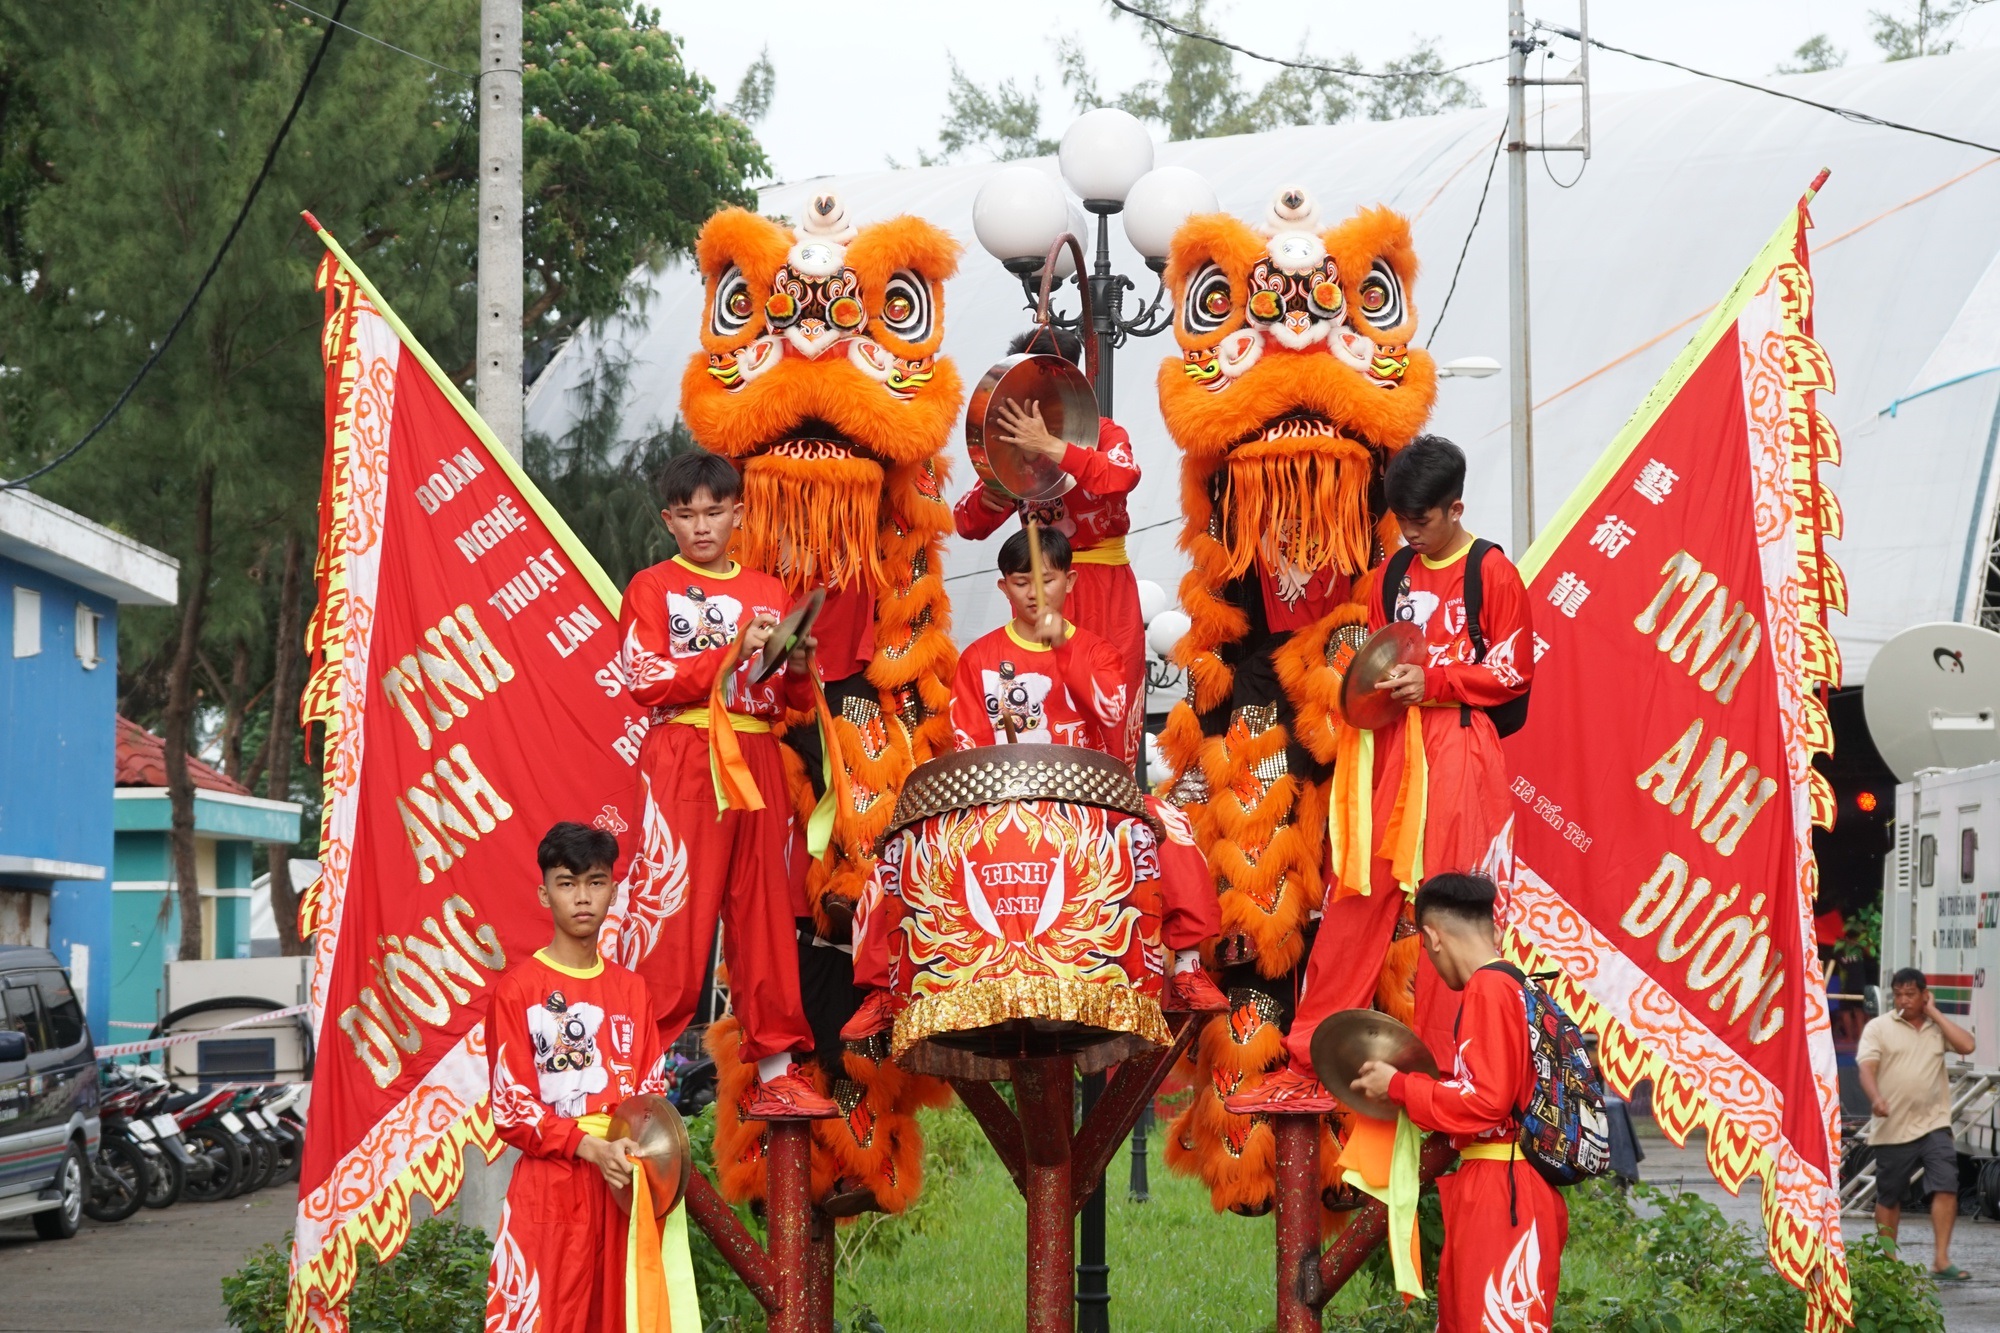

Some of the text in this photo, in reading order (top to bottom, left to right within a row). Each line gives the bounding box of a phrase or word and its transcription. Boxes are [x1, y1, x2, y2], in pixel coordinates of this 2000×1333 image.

[414, 447, 485, 516] ĐOÀN
[454, 494, 527, 564] NGHỆ
[487, 548, 566, 621] THUẬT
[546, 604, 602, 658] LÂN
[1633, 549, 1761, 705] TINH
[382, 603, 515, 750] TINH
[396, 743, 513, 884] ANH
[1510, 776, 1593, 853] Hà Tấn Tài
[1636, 717, 1777, 857] ANH
[982, 861, 1049, 886] TINH
[994, 897, 1040, 915] ANH
